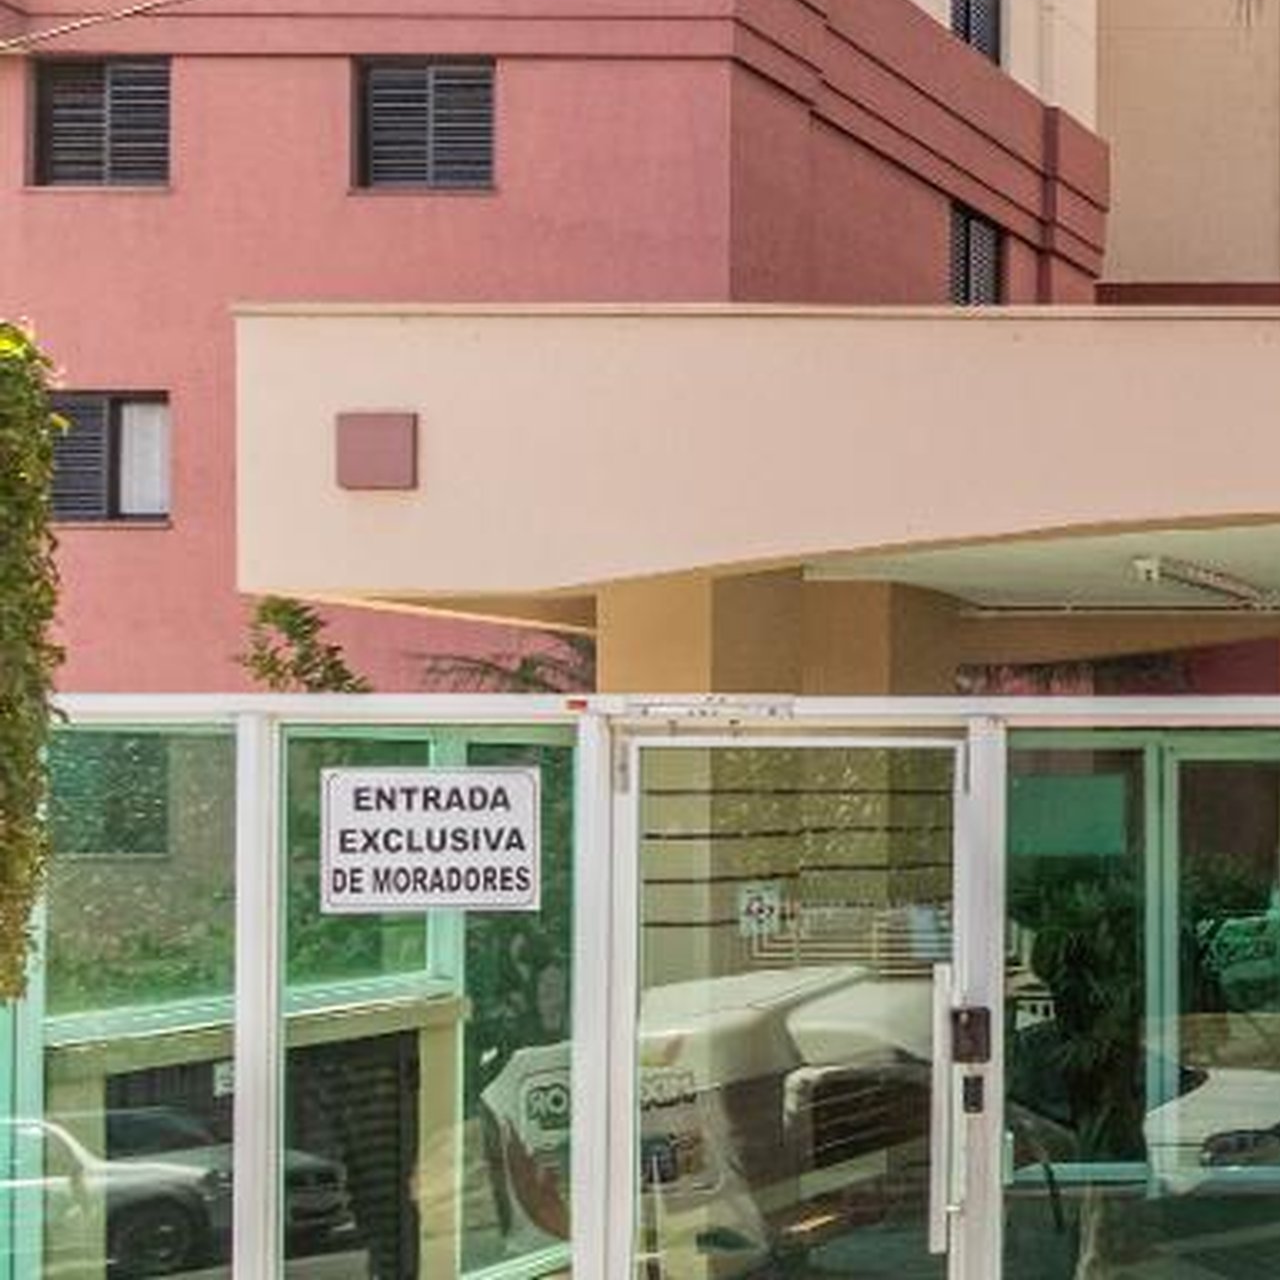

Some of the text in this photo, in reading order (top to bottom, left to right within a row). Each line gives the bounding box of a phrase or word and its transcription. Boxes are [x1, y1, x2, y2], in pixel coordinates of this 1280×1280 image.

[353, 785, 511, 812] ENTRADA
[338, 827, 526, 854] EXCLUSIVA
[332, 865, 532, 894] DE MORADORES
